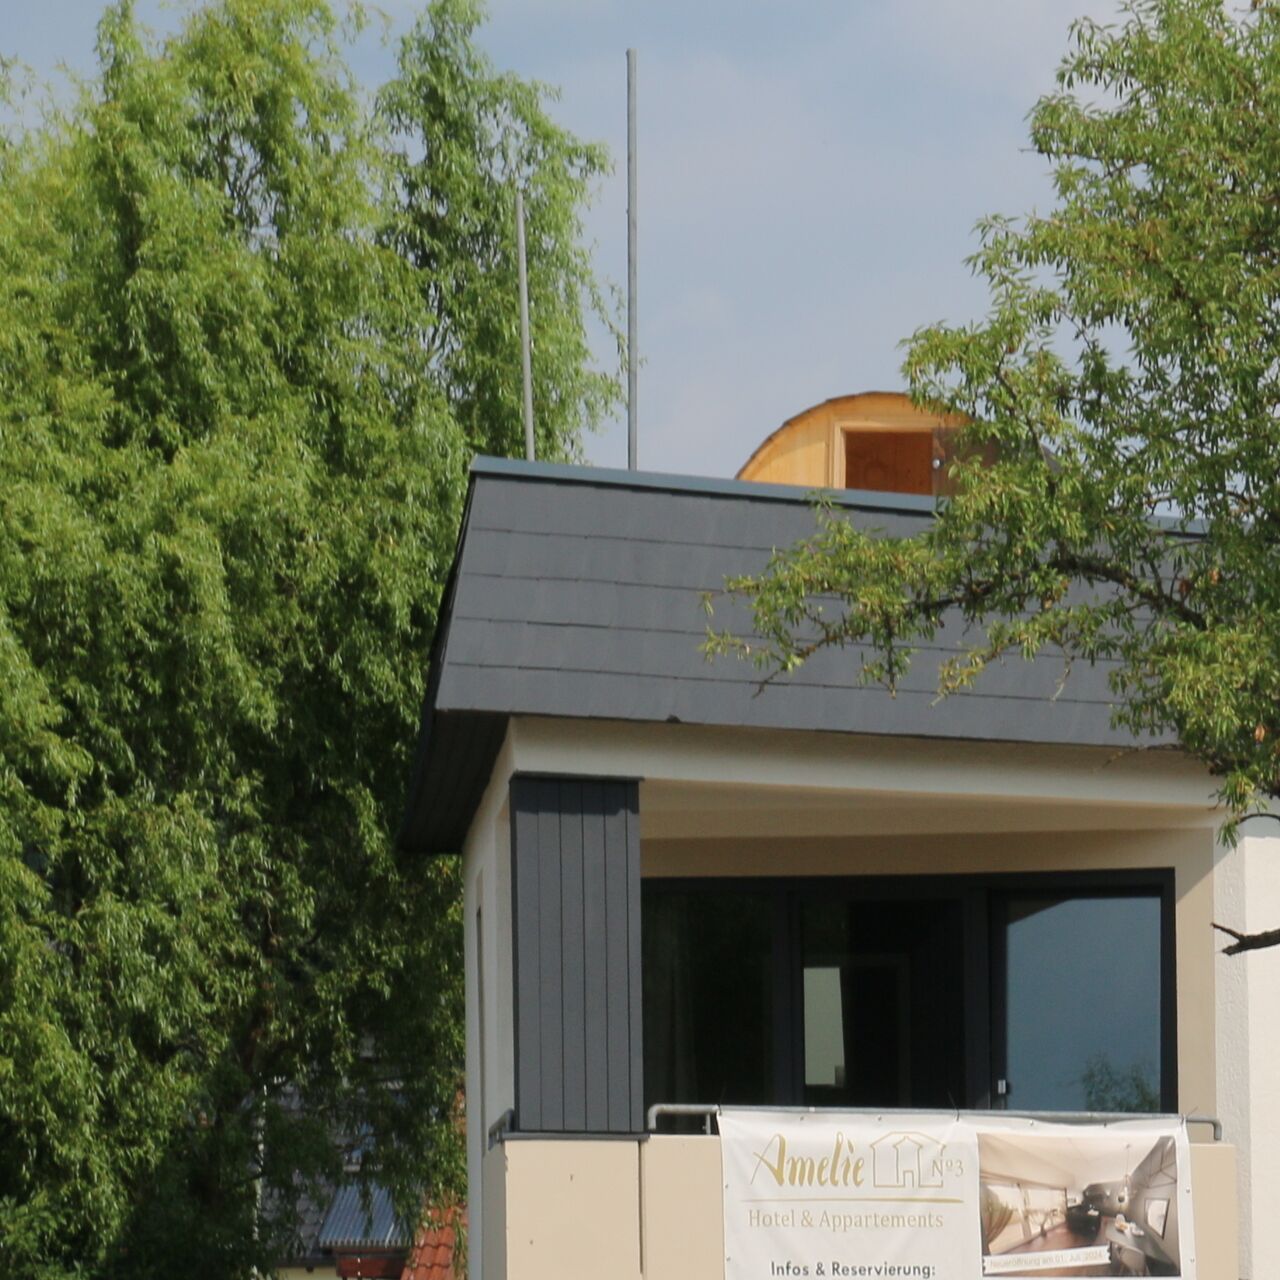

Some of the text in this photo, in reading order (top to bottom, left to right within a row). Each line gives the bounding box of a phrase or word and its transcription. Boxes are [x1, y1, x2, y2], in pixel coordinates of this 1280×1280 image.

[751, 1131, 865, 1188] Amelie
[749, 1210, 944, 1233] Hotel & Appartements
[771, 1261, 936, 1280] Infos & Reservierung:
